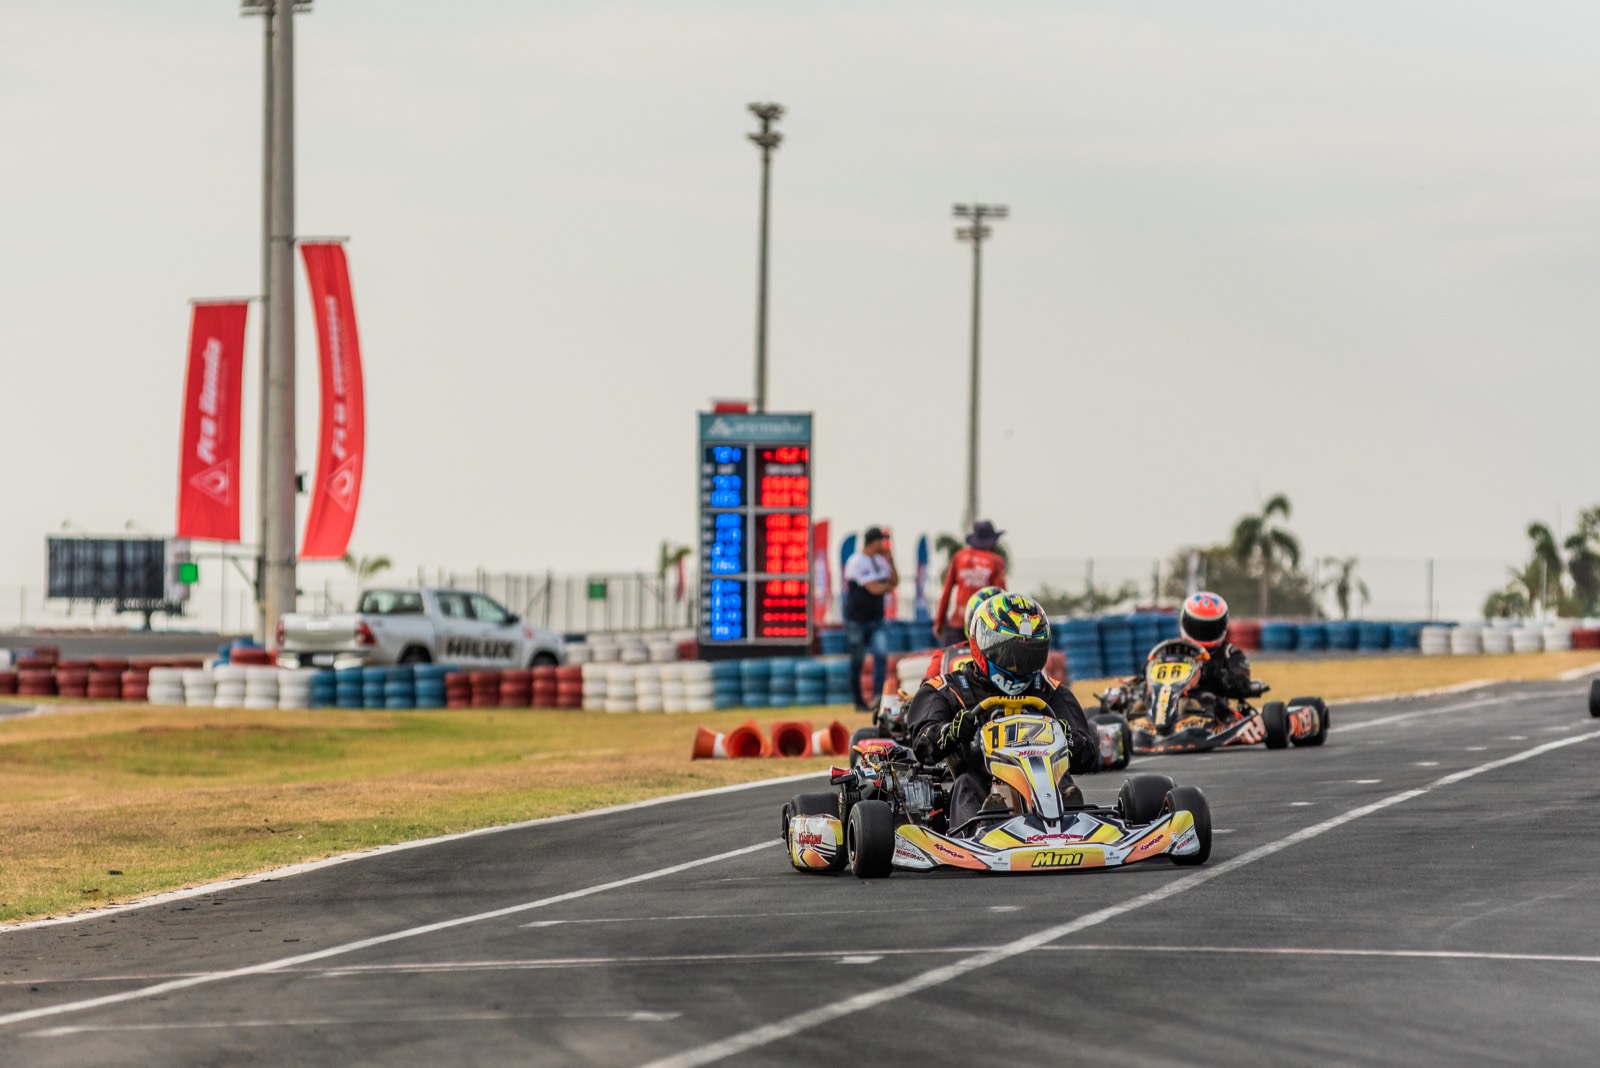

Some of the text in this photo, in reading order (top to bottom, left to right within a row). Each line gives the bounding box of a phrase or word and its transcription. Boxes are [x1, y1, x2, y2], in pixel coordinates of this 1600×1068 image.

[446, 637, 515, 659] HILUX
[1157, 665, 1181, 679] 66
[988, 721, 1047, 749] 117
[1032, 851, 1083, 868] Mini
